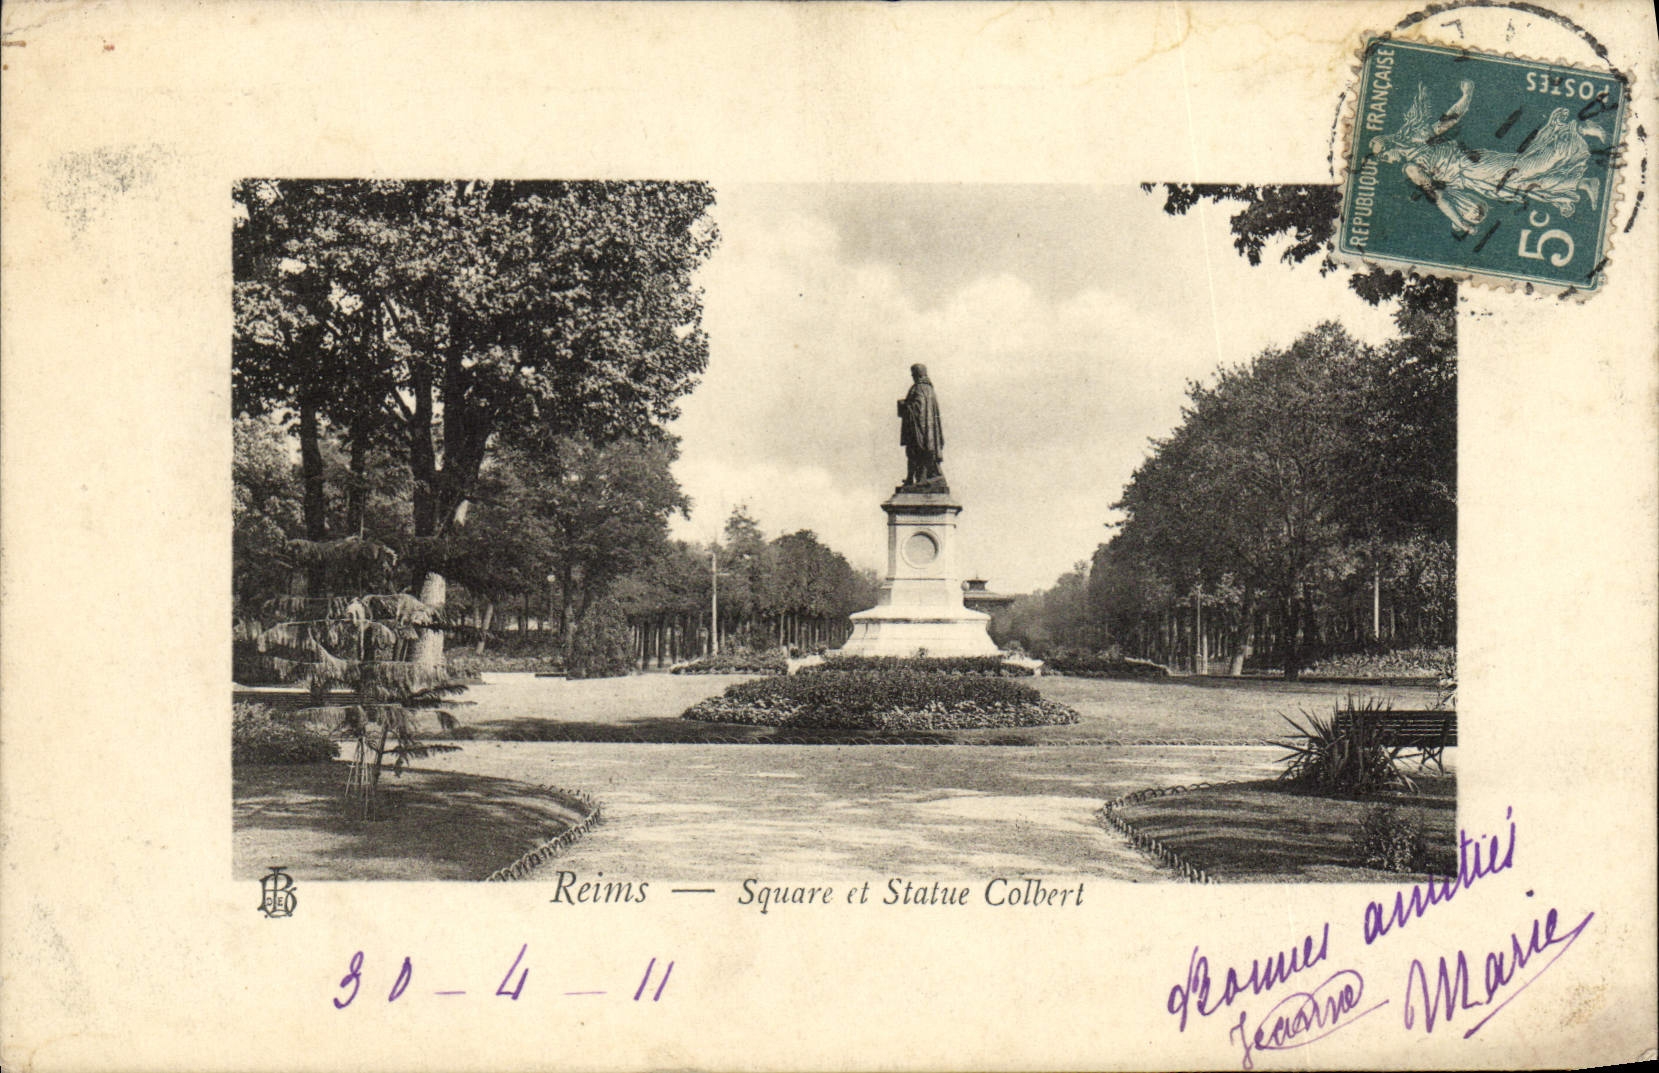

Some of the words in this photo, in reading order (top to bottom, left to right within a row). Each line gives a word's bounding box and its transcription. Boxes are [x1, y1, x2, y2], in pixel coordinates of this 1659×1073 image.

[1366, 48, 1395, 132] FRANÇAISE
[1526, 71, 1610, 104] POSTES
[1404, 889, 1594, 1038] Marie
